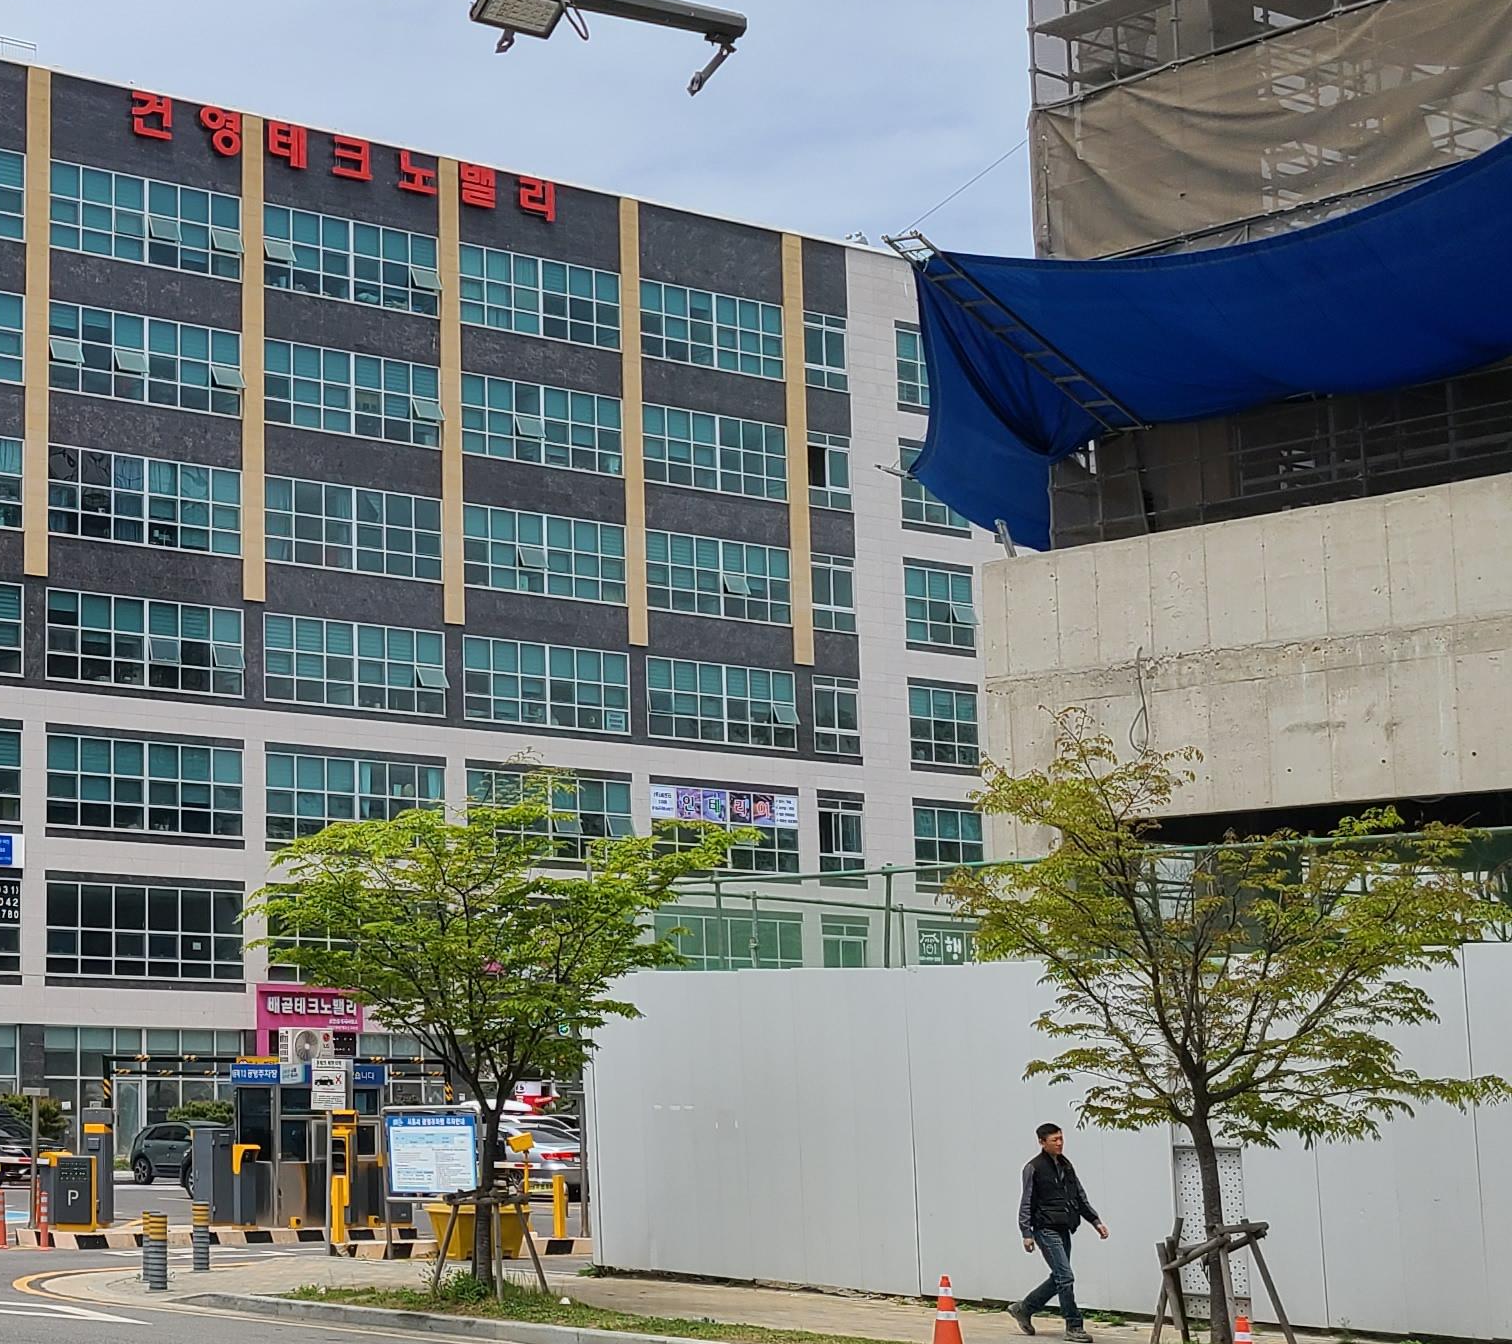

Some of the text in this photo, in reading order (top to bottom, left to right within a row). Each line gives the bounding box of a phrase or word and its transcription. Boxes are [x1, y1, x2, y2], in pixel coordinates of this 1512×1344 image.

[131, 90, 556, 223] 건영테크노밸리
[266, 995, 358, 1017] 배곧테크노밸리
[67, 1189, 79, 1207] P
